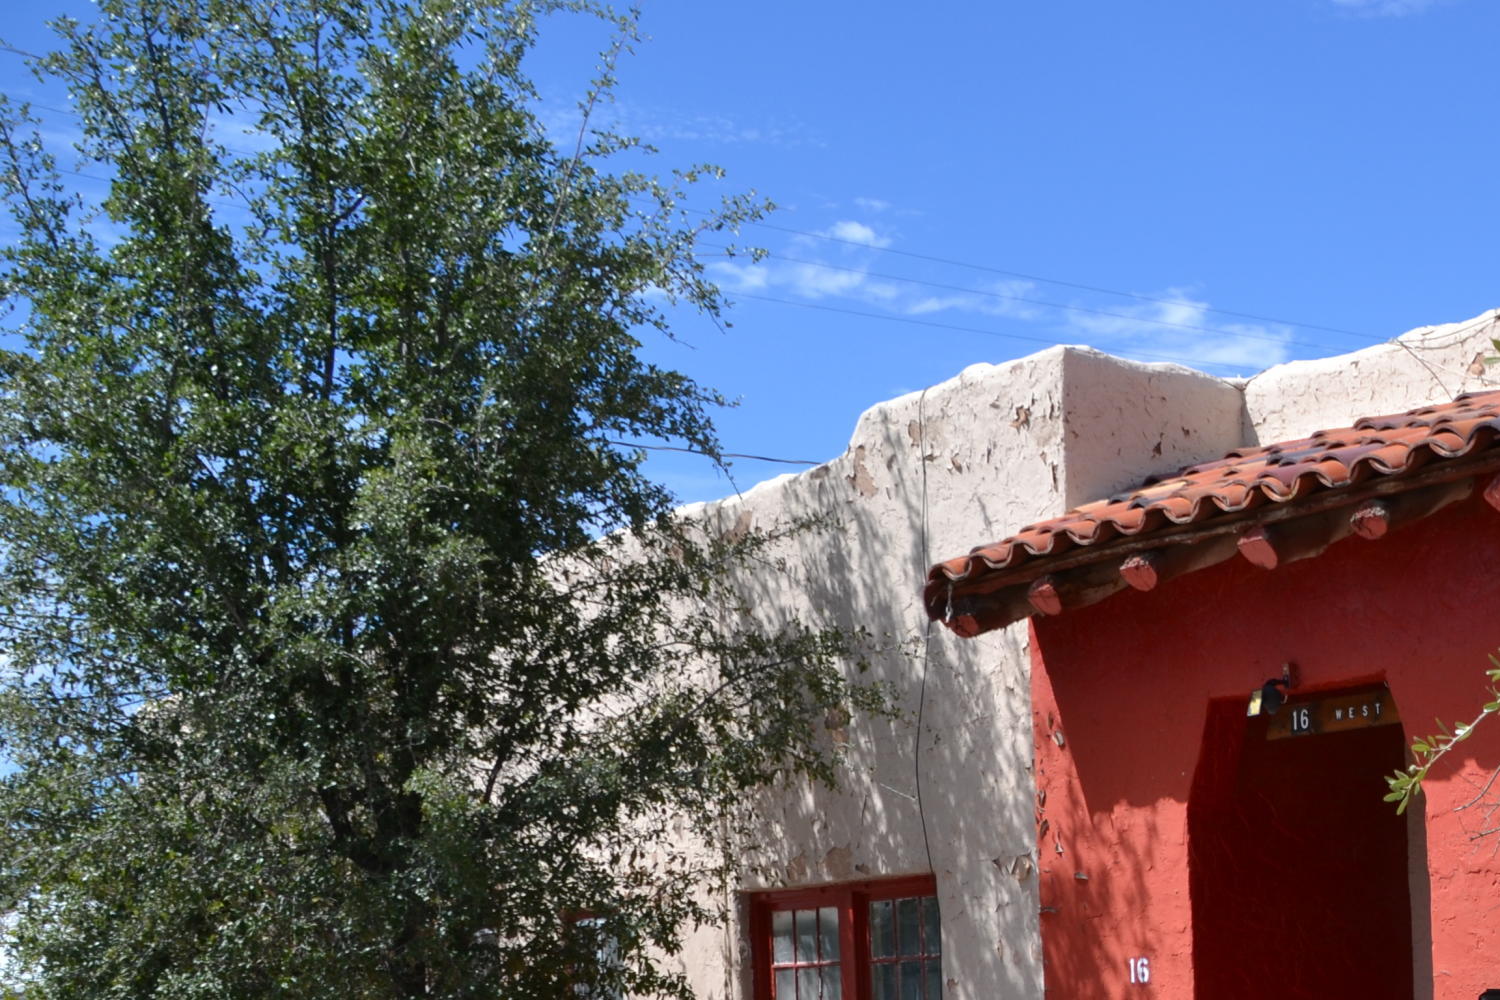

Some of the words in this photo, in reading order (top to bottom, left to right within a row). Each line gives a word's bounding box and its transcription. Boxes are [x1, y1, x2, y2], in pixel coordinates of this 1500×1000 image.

[1293, 709, 1309, 730] 16
[1335, 703, 1381, 720] WEST
[1129, 957, 1149, 984] 16
